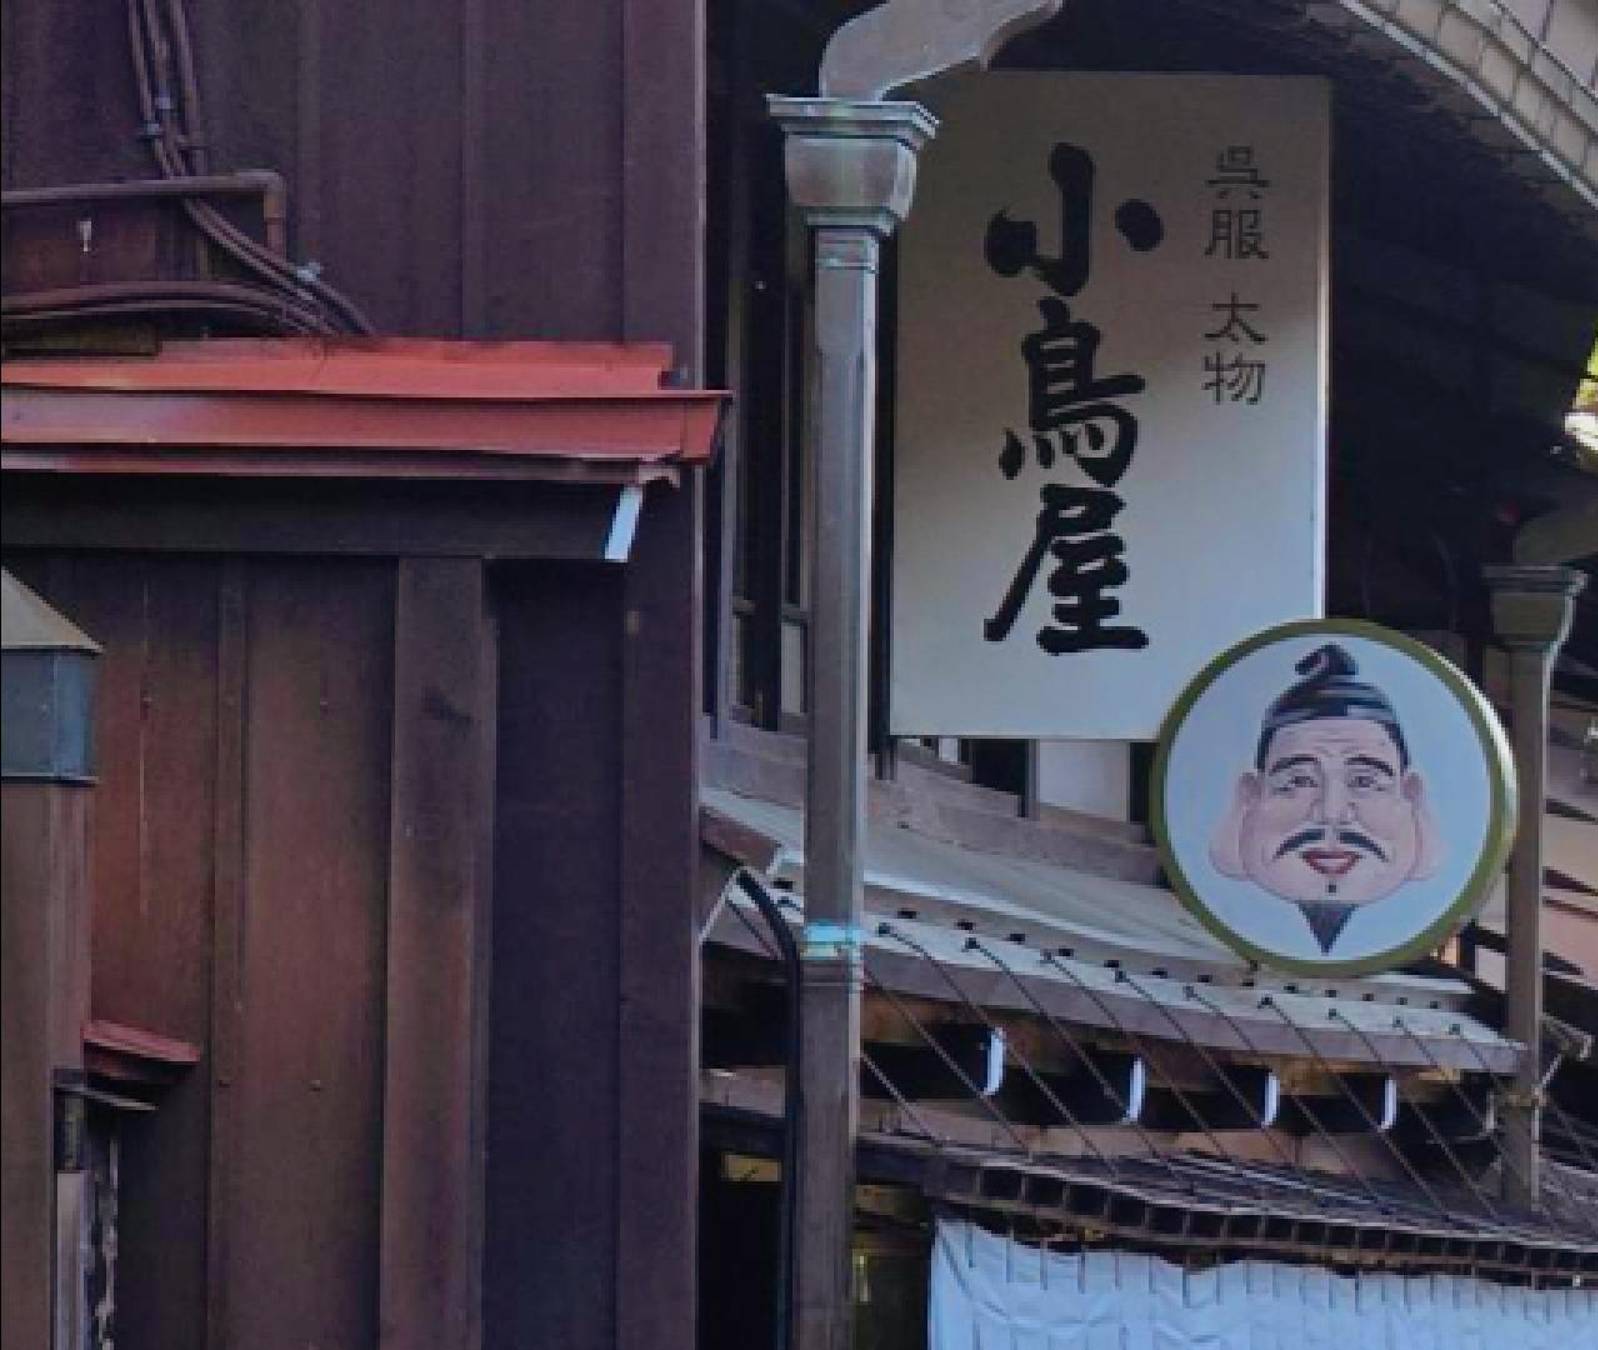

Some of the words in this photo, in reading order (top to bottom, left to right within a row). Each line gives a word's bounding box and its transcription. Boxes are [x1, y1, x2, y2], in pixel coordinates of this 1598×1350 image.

[1203, 146, 1270, 264] 呉服
[983, 141, 1165, 656] 小鳥屋
[1203, 293, 1268, 406] 太物
